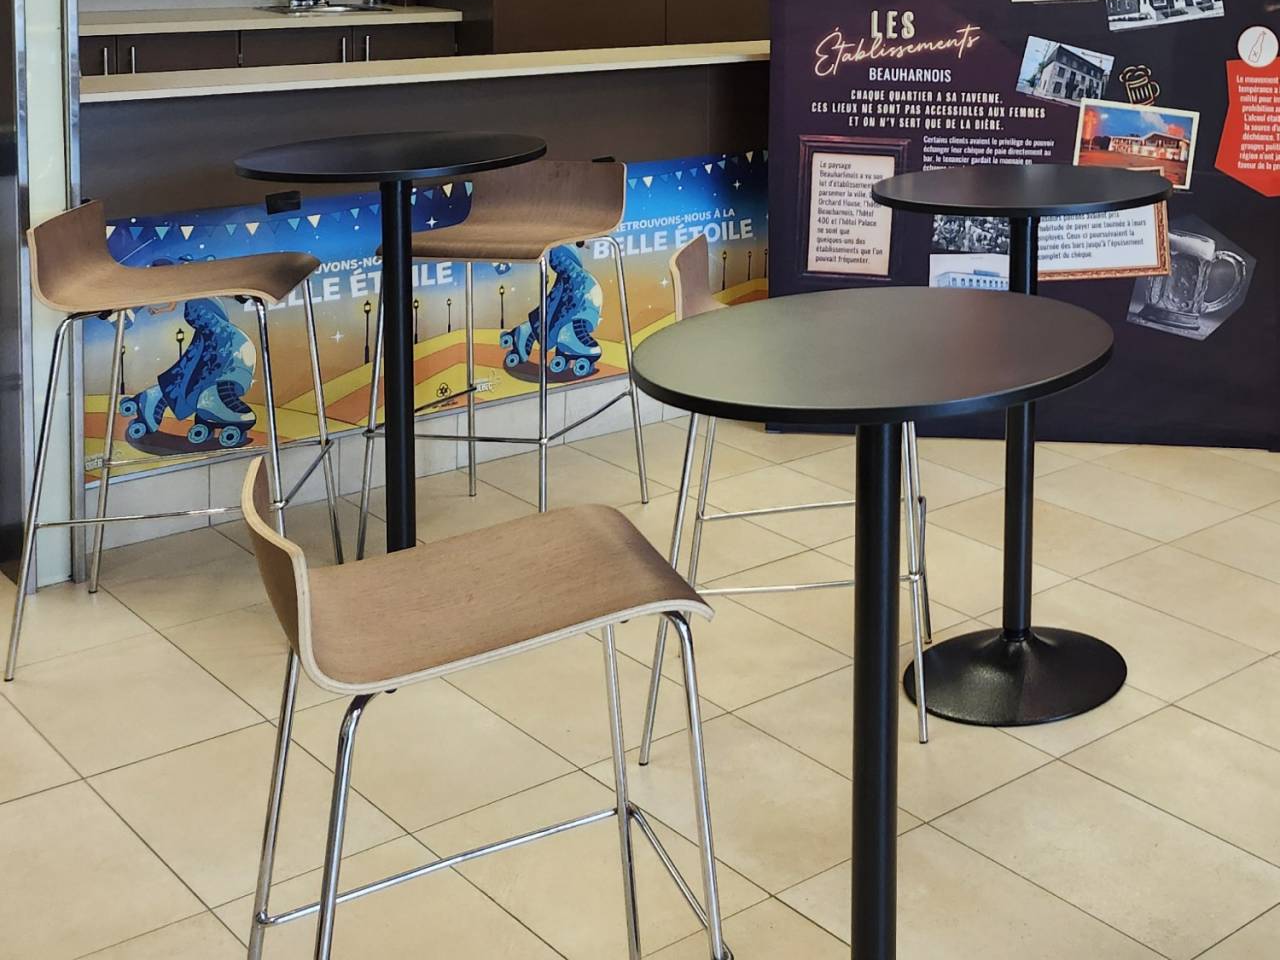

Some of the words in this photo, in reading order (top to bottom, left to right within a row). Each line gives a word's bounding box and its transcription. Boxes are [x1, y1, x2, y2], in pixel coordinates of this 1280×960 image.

[871, 10, 915, 39] LES
[814, 23, 981, 76] Établissements
[869, 67, 952, 83] BEAUHARNOIS
[851, 90, 884, 101] CHAQUE
[889, 91, 933, 102] QUARTIER
[945, 92, 957, 102] SA
[961, 92, 1004, 103] TAVERNE.
[811, 102, 828, 113] CES
[832, 103, 857, 114] LIEUX
[861, 104, 872, 114] NE
[877, 104, 900, 115] SONT
[904, 105, 921, 115] PAS
[925, 105, 984, 116] ACCESSIBLES
[988, 107, 1005, 117] AUX
[1009, 107, 1047, 118] FEMMES
[848, 117, 858, 127] ET
[863, 117, 876, 128] ON
[899, 118, 920, 128] SERT
[925, 119, 941, 129] QUE
[945, 119, 956, 129] DE
[960, 120, 971, 129] LA
[617, 213, 711, 232] ETROUVONS-NOUS
[714, 208, 720, 218] À
[723, 208, 735, 217] LA
[350, 262, 453, 298] ÉTILE
